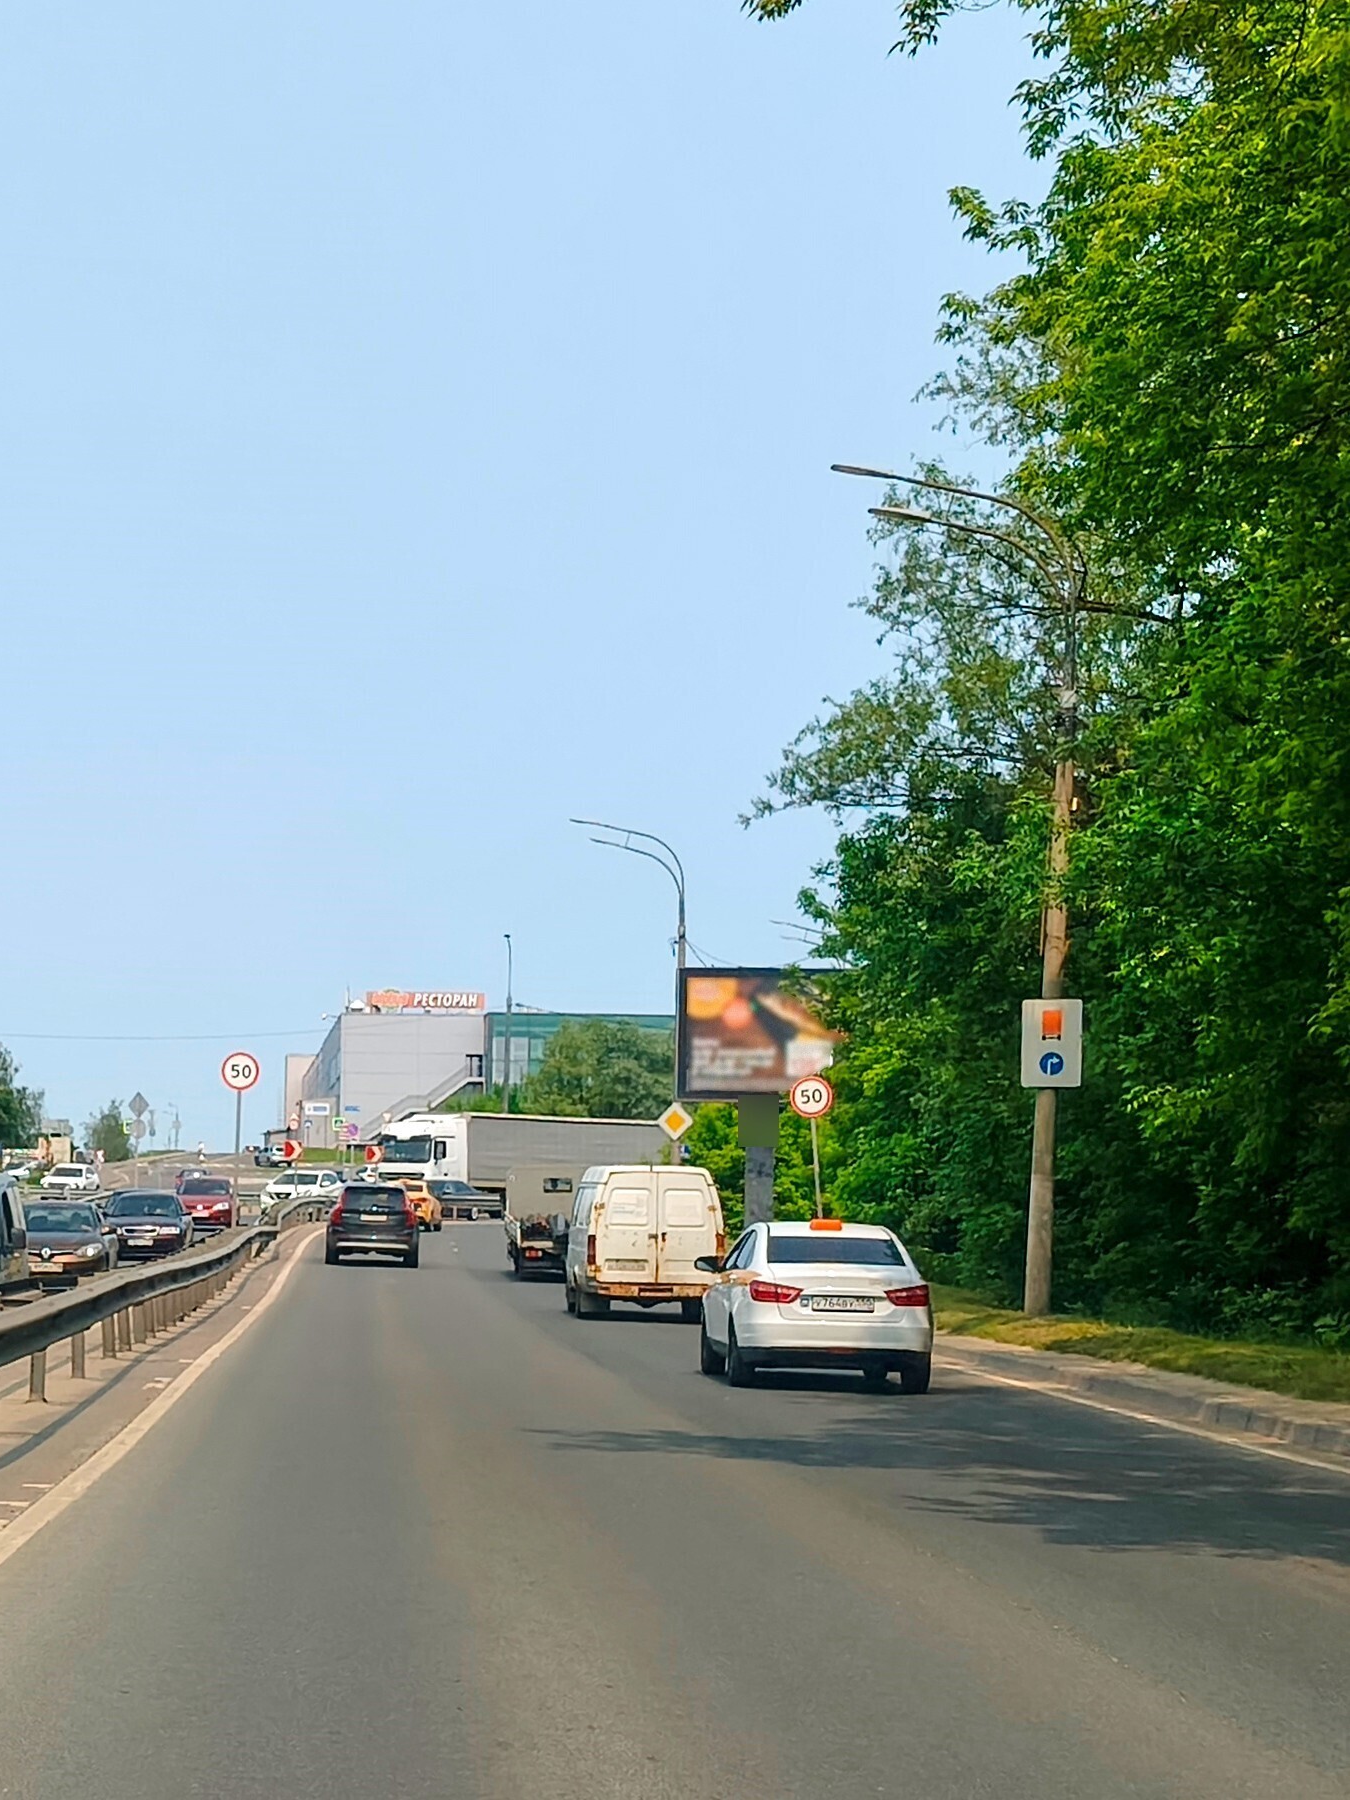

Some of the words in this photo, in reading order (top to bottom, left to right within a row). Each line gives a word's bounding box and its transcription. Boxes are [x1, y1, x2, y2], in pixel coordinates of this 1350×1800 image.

[413, 993, 478, 1008] РЕСТОРАН
[231, 1064, 252, 1079] 50
[801, 1088, 823, 1104] 50
